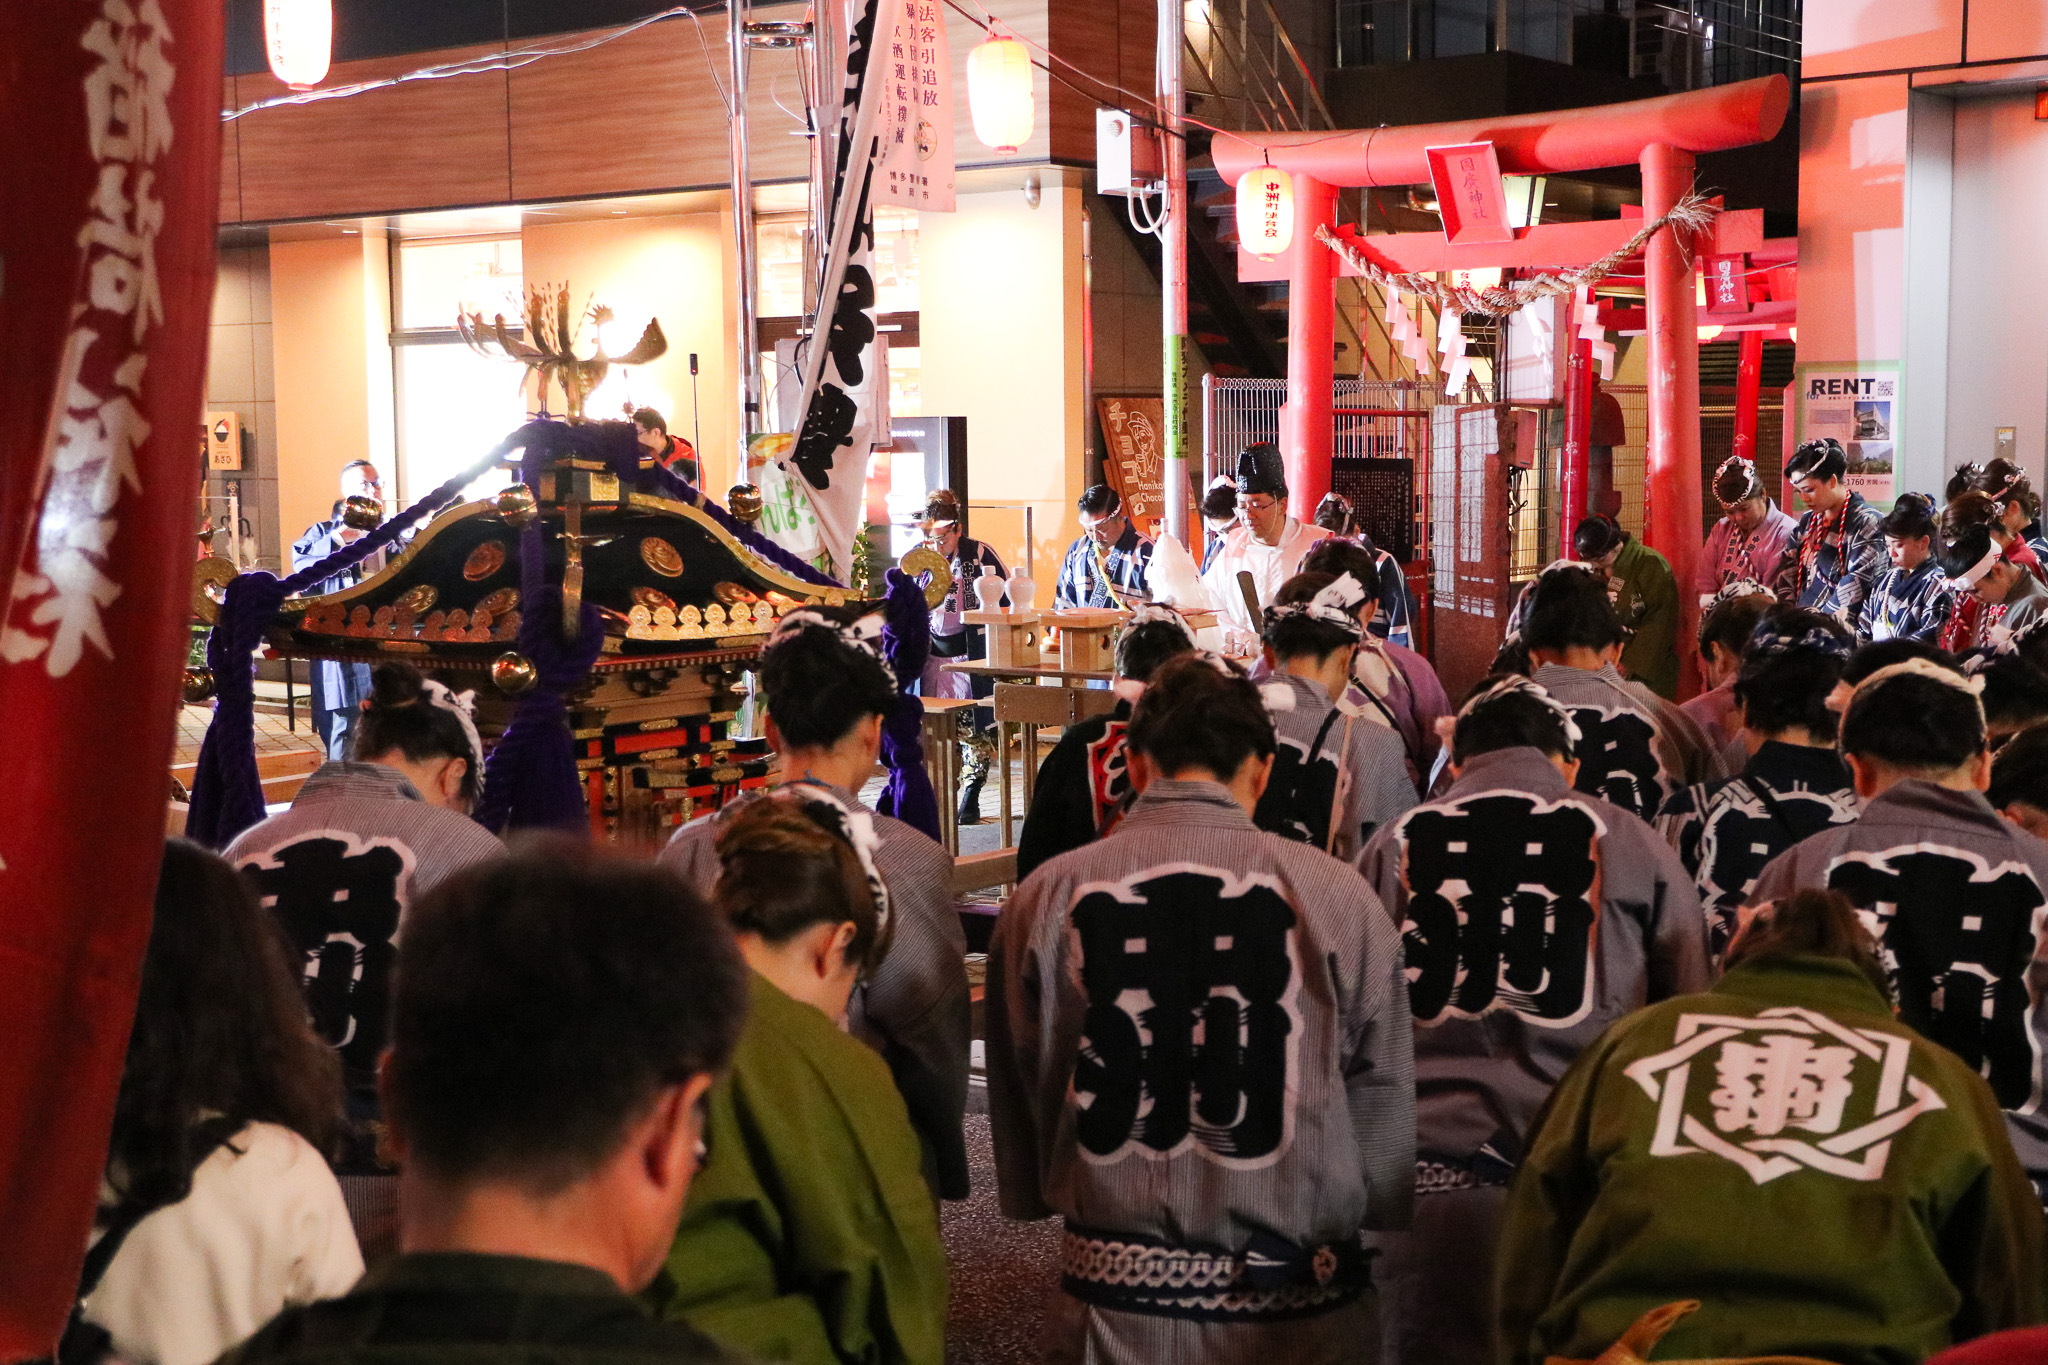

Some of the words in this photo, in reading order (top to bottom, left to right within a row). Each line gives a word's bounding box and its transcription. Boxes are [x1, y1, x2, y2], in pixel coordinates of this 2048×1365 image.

[918, 0, 939, 106] 法客引追放
[1811, 378, 1876, 395] RENT
[1806, 391, 1820, 400] for
[1109, 401, 1139, 485] チョコ
[214, 455, 232, 464] あさひ
